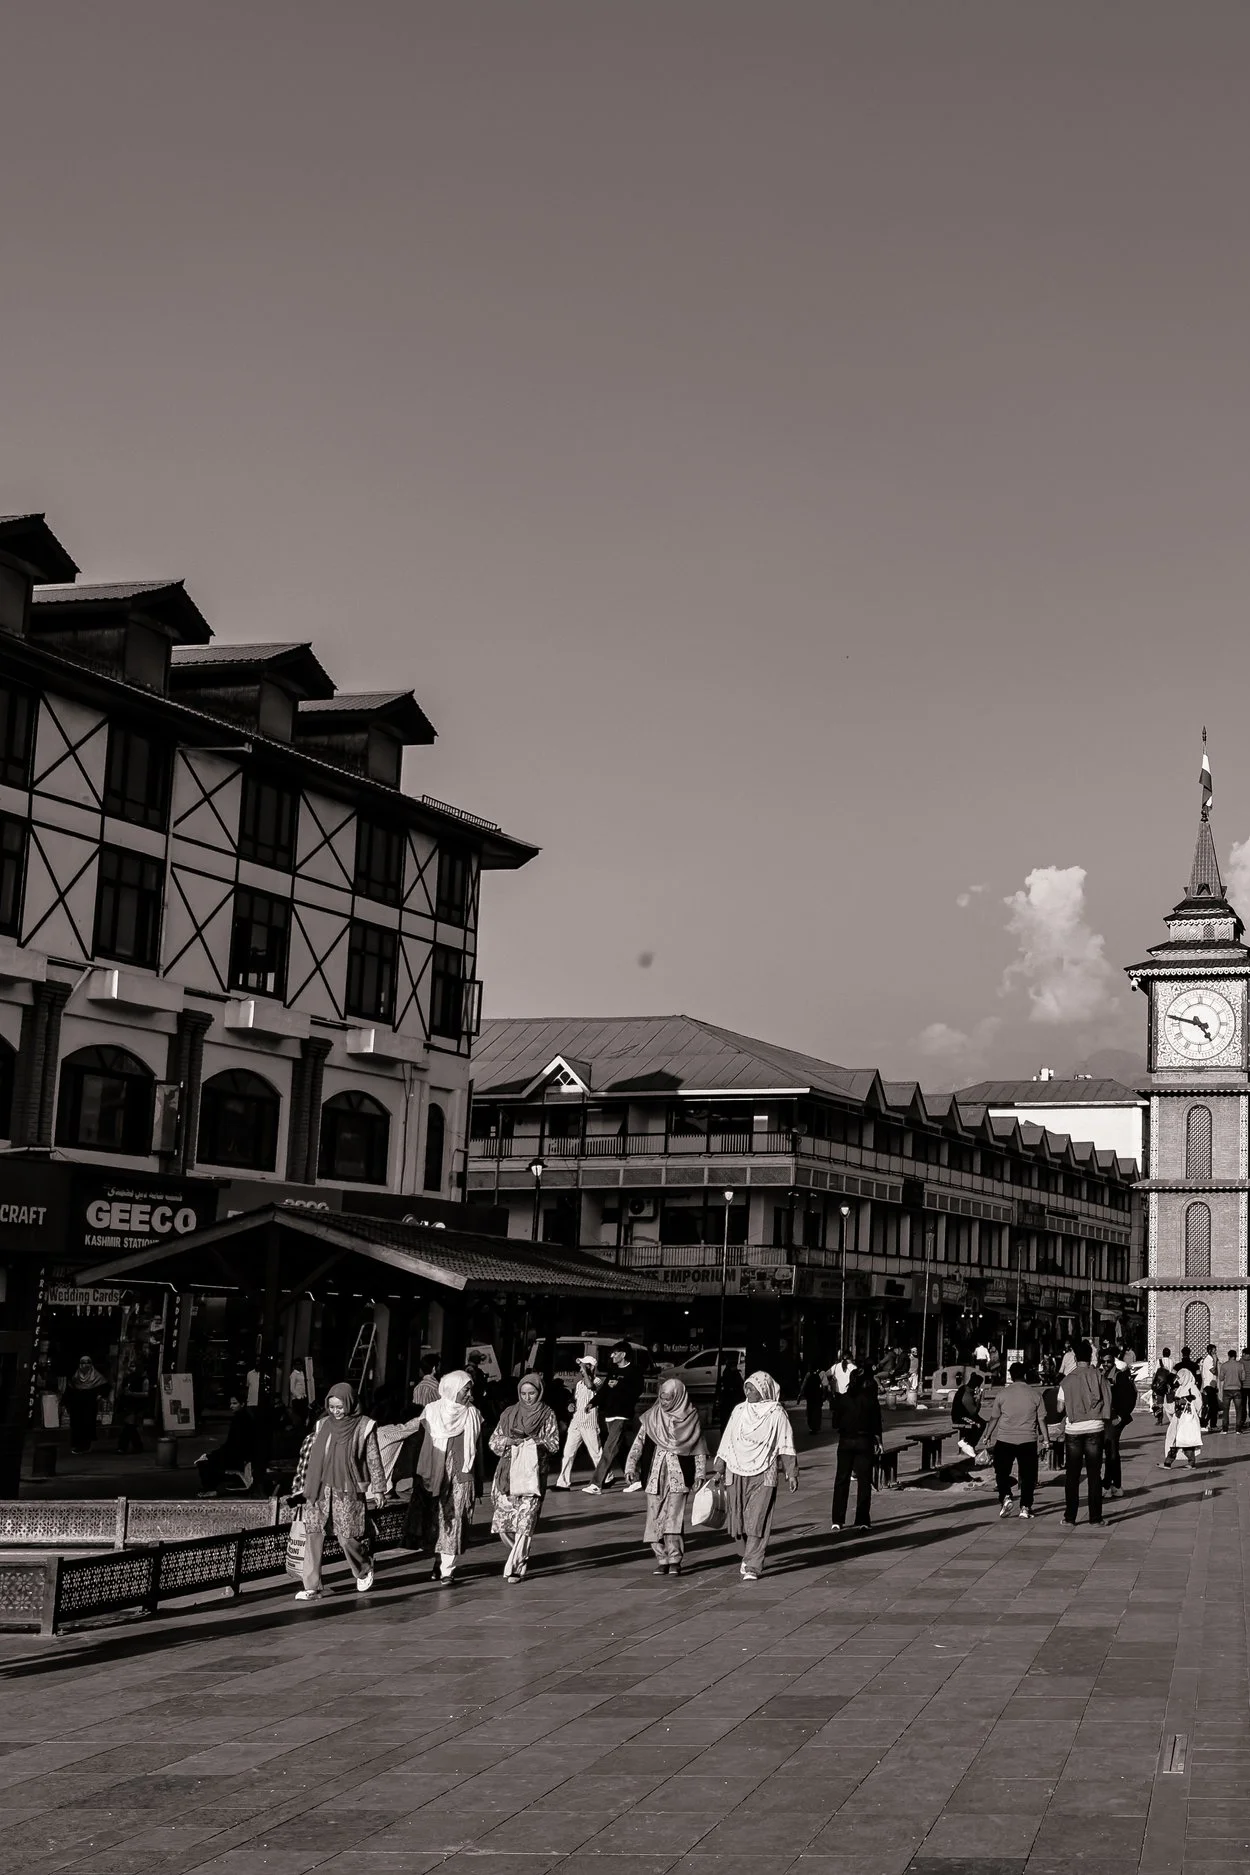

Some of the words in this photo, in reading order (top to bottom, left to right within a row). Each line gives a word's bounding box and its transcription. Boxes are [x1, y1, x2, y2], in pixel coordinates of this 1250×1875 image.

[0, 1203, 47, 1225] CRAFT
[86, 1199, 197, 1235] GEECO
[84, 1234, 121, 1249] KASHMIR
[663, 1268, 737, 1283] EMPORIUM
[48, 1286, 90, 1304] Wedding
[92, 1288, 119, 1302] Cards
